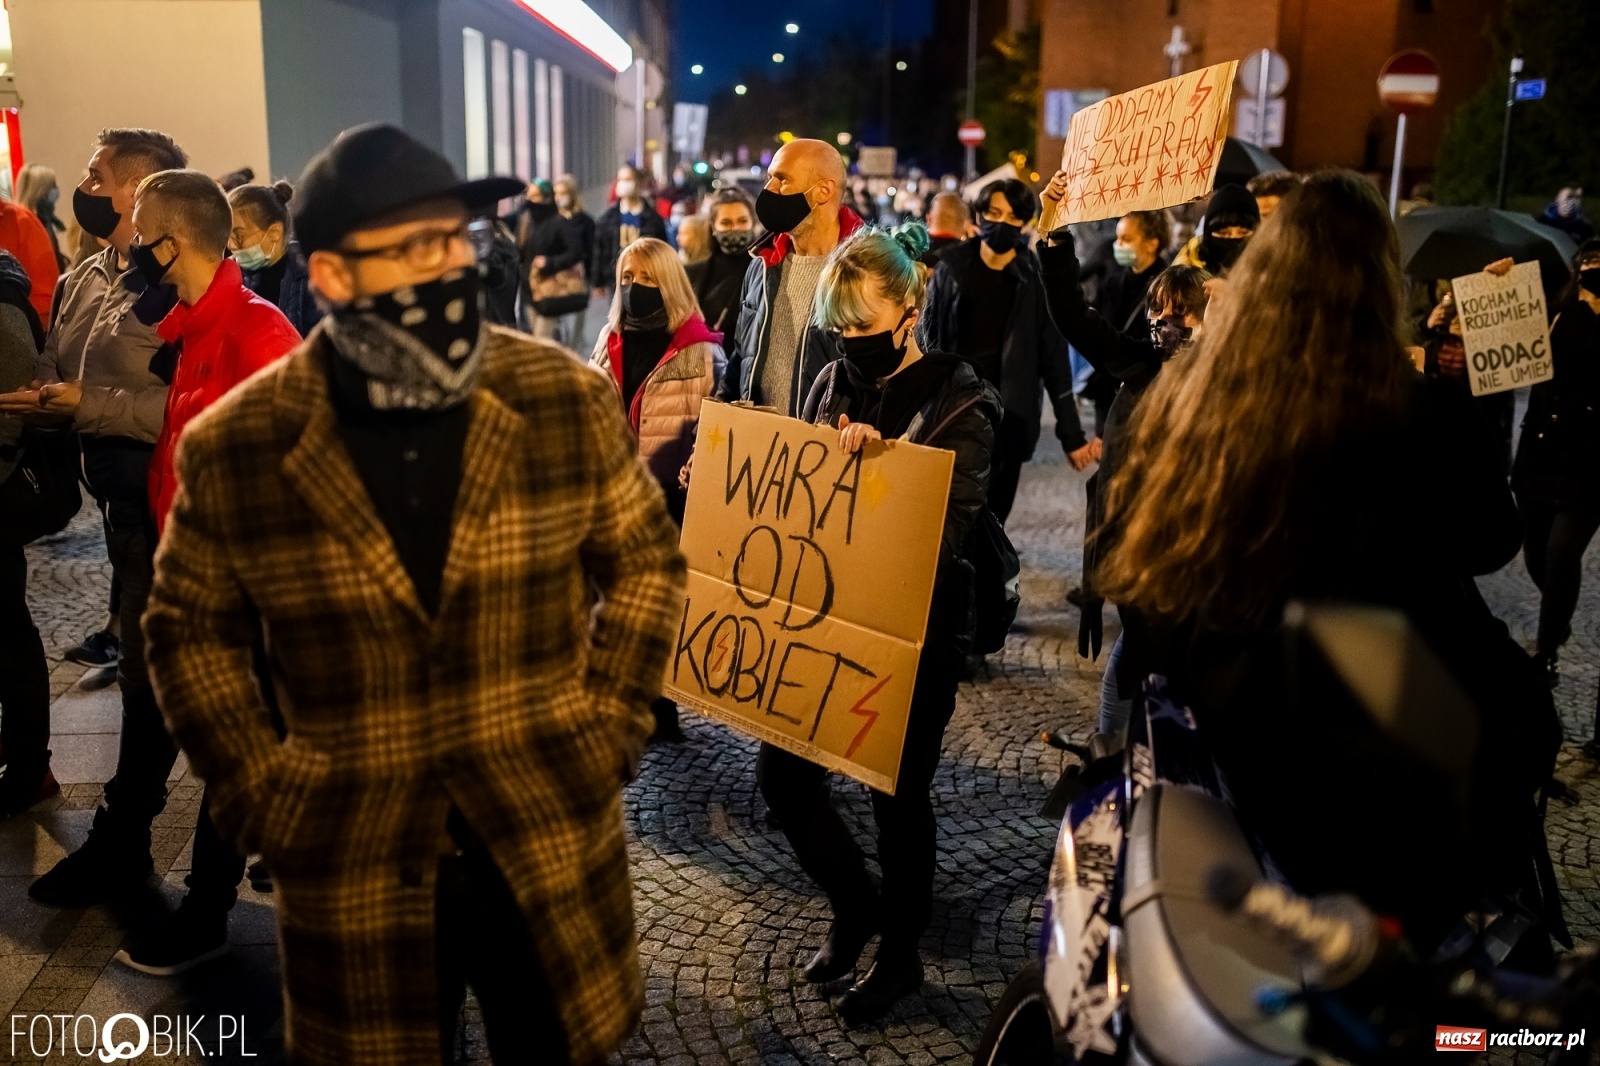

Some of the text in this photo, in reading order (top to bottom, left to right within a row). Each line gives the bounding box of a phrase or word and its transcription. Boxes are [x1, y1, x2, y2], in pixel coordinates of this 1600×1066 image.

[1065, 109, 1221, 185] NASZYCH PRAW
[1067, 80, 1184, 152] NIE ODDAMY
[1461, 285, 1533, 316] KOCHAM I
[1465, 299, 1543, 331] ROZUMIEM
[1472, 335, 1546, 373] ODDAĆ
[1478, 371, 1503, 392] NIE
[725, 428, 862, 545] WARA
[733, 524, 834, 631] OD
[673, 597, 877, 742] KOBIET
